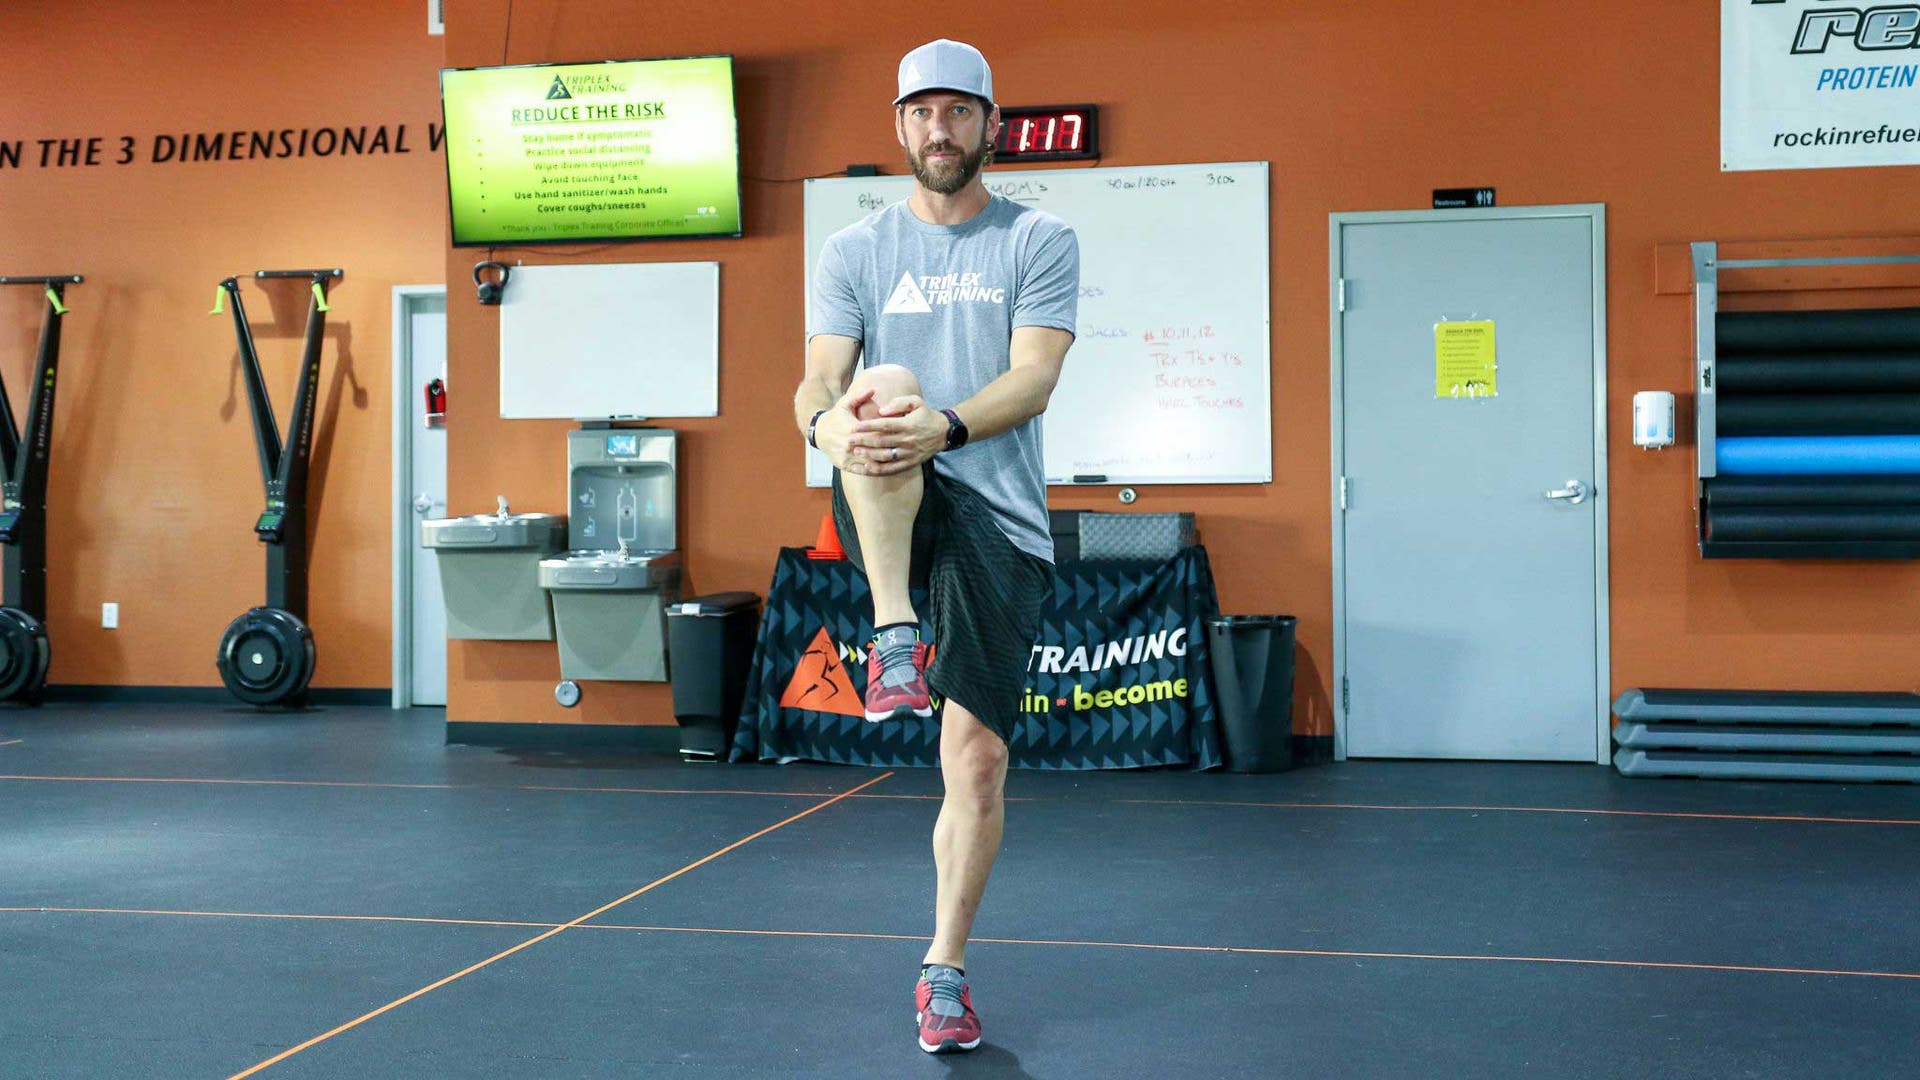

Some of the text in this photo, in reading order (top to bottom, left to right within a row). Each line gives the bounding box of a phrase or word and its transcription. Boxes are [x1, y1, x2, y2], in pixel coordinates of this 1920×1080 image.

[1790, 4, 1920, 55] re
[565, 74, 612, 86] TRIPLEX
[1816, 64, 1918, 91] PROTEIN
[571, 83, 626, 94] TRAINING
[511, 102, 665, 122] REDUCE THE RISK
[37, 137, 102, 168] THE
[116, 136, 135, 165] 3
[151, 124, 411, 163] DIMENSIONAL
[542, 173, 639, 184] Avoid touching face
[514, 186, 668, 200] Use hand sanitizer/wash hands
[538, 202, 647, 214] Cover coughs/sneezes
[1073, 678, 1188, 711] become
